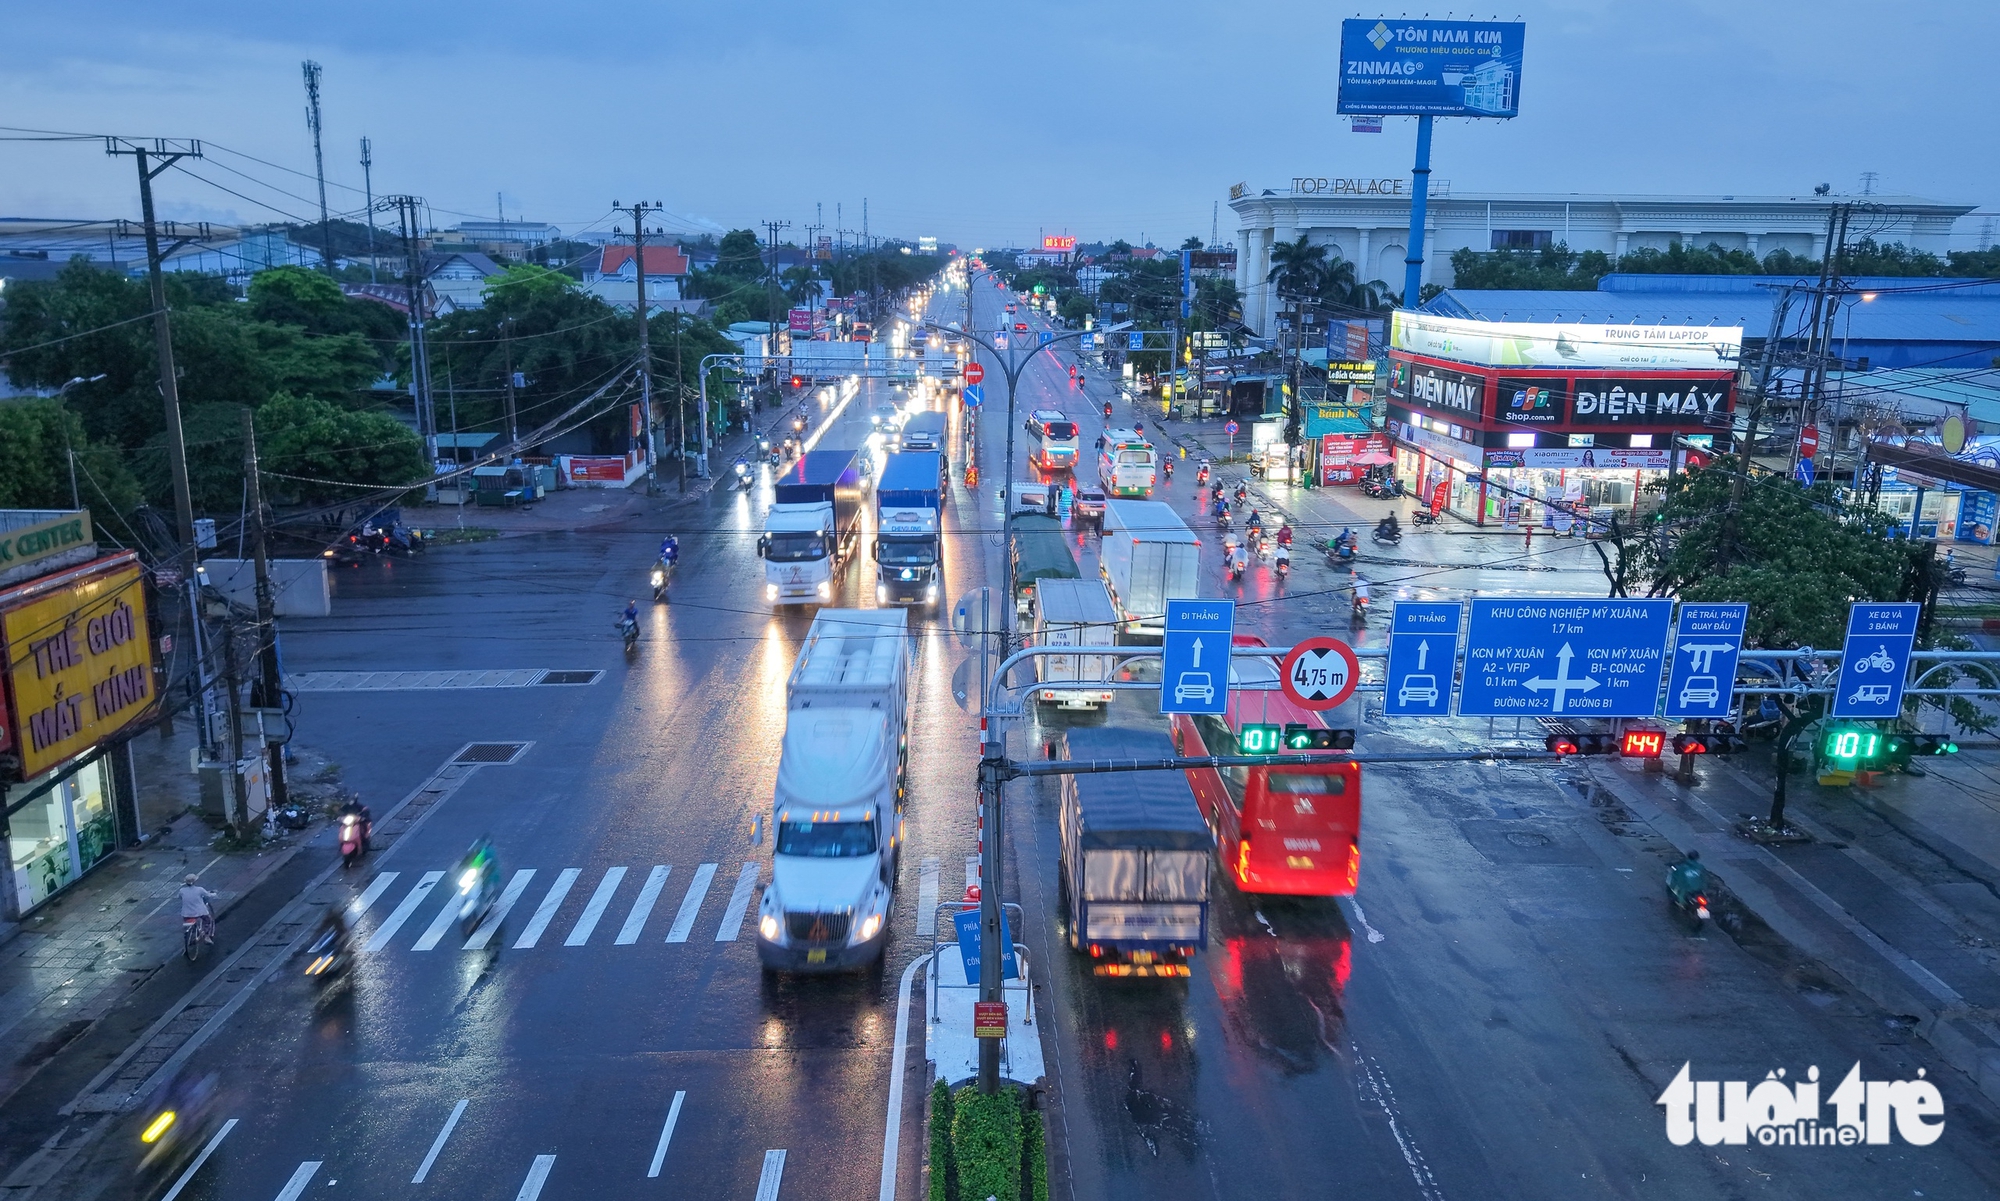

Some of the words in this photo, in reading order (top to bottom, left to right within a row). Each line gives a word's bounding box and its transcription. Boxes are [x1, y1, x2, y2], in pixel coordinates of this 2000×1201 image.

[1396, 26, 1428, 42] TÔN
[1432, 29, 1469, 43] NAM
[1474, 30, 1502, 44] KIM
[1395, 46, 1428, 54] THƯƠNG
[1430, 46, 1450, 55] HIỆU
[1452, 46, 1475, 55] QUỐC
[1292, 178, 1328, 194] TOP
[1334, 178, 1403, 195] PALACE
[1605, 328, 1641, 339] TRUNG
[1644, 327, 1666, 340] TÂM
[1669, 330, 1709, 341] LAPTOP
[1413, 370, 1443, 408] ĐIỆN
[1445, 376, 1477, 411] MÁY
[1576, 385, 1648, 421] ĐIỆN
[1656, 385, 1723, 416] MÁY
[1318, 408, 1345, 418] Bánh
[1506, 412, 1555, 421] Shop.com.vn
[1620, 458, 1627, 468] 5
[16, 518, 84, 557] CENTER
[1181, 612, 1190, 621] ĐI
[1191, 608, 1220, 621] THẲNG
[1408, 614, 1417, 623] ĐI
[1418, 610, 1447, 623] THẲNG
[1491, 607, 1515, 619] KHU
[1516, 605, 1547, 619] CÔNG
[1549, 605, 1590, 621] NGHIỆP
[1592, 605, 1608, 619] MỸ
[1609, 606, 1639, 620] XUÂN
[1639, 609, 1648, 619] A
[1687, 609, 1698, 619] RẼ
[1721, 608, 1740, 619] PHẢI
[1868, 611, 1880, 619] XE
[1881, 611, 1891, 619] 02
[1892, 609, 1903, 619] VÀ
[1552, 624, 1566, 634] 1.7
[1567, 624, 1583, 635] km
[1691, 621, 1712, 631] QUAY
[1713, 619, 1731, 631] ĐẦU
[1868, 622, 1874, 630] 3
[1875, 620, 1899, 631] BÁNH
[29, 611, 83, 680] THẾ
[87, 596, 136, 656] GIỚI
[1472, 648, 1495, 659] KCN
[1496, 646, 1513, 659] MỸ
[1513, 647, 1545, 659] XUÂN
[1587, 648, 1610, 660] KCN
[1611, 646, 1627, 660] MỸ
[1628, 647, 1659, 660] XUÂN
[1482, 663, 1497, 673] A2
[1506, 663, 1530, 673] VFIP
[1609, 663, 1646, 674] CONAC
[1331, 673, 1343, 685] m
[1485, 677, 1500, 687] 0.1
[1501, 677, 1517, 687] km
[1607, 678, 1611, 687] 1
[1613, 677, 1629, 688] km
[29, 682, 85, 753] MẮT
[93, 663, 149, 722] KÍNH
[1493, 695, 1526, 708] ĐƯỜNG
[1527, 698, 1549, 708] N2-2
[1568, 695, 1601, 708] ĐƯỜNG
[1602, 698, 1613, 708] B1
[1244, 729, 1277, 750] 101
[1626, 734, 1660, 753] 144
[1834, 732, 1877, 758] 101
[963, 920, 979, 932] PHÍA
